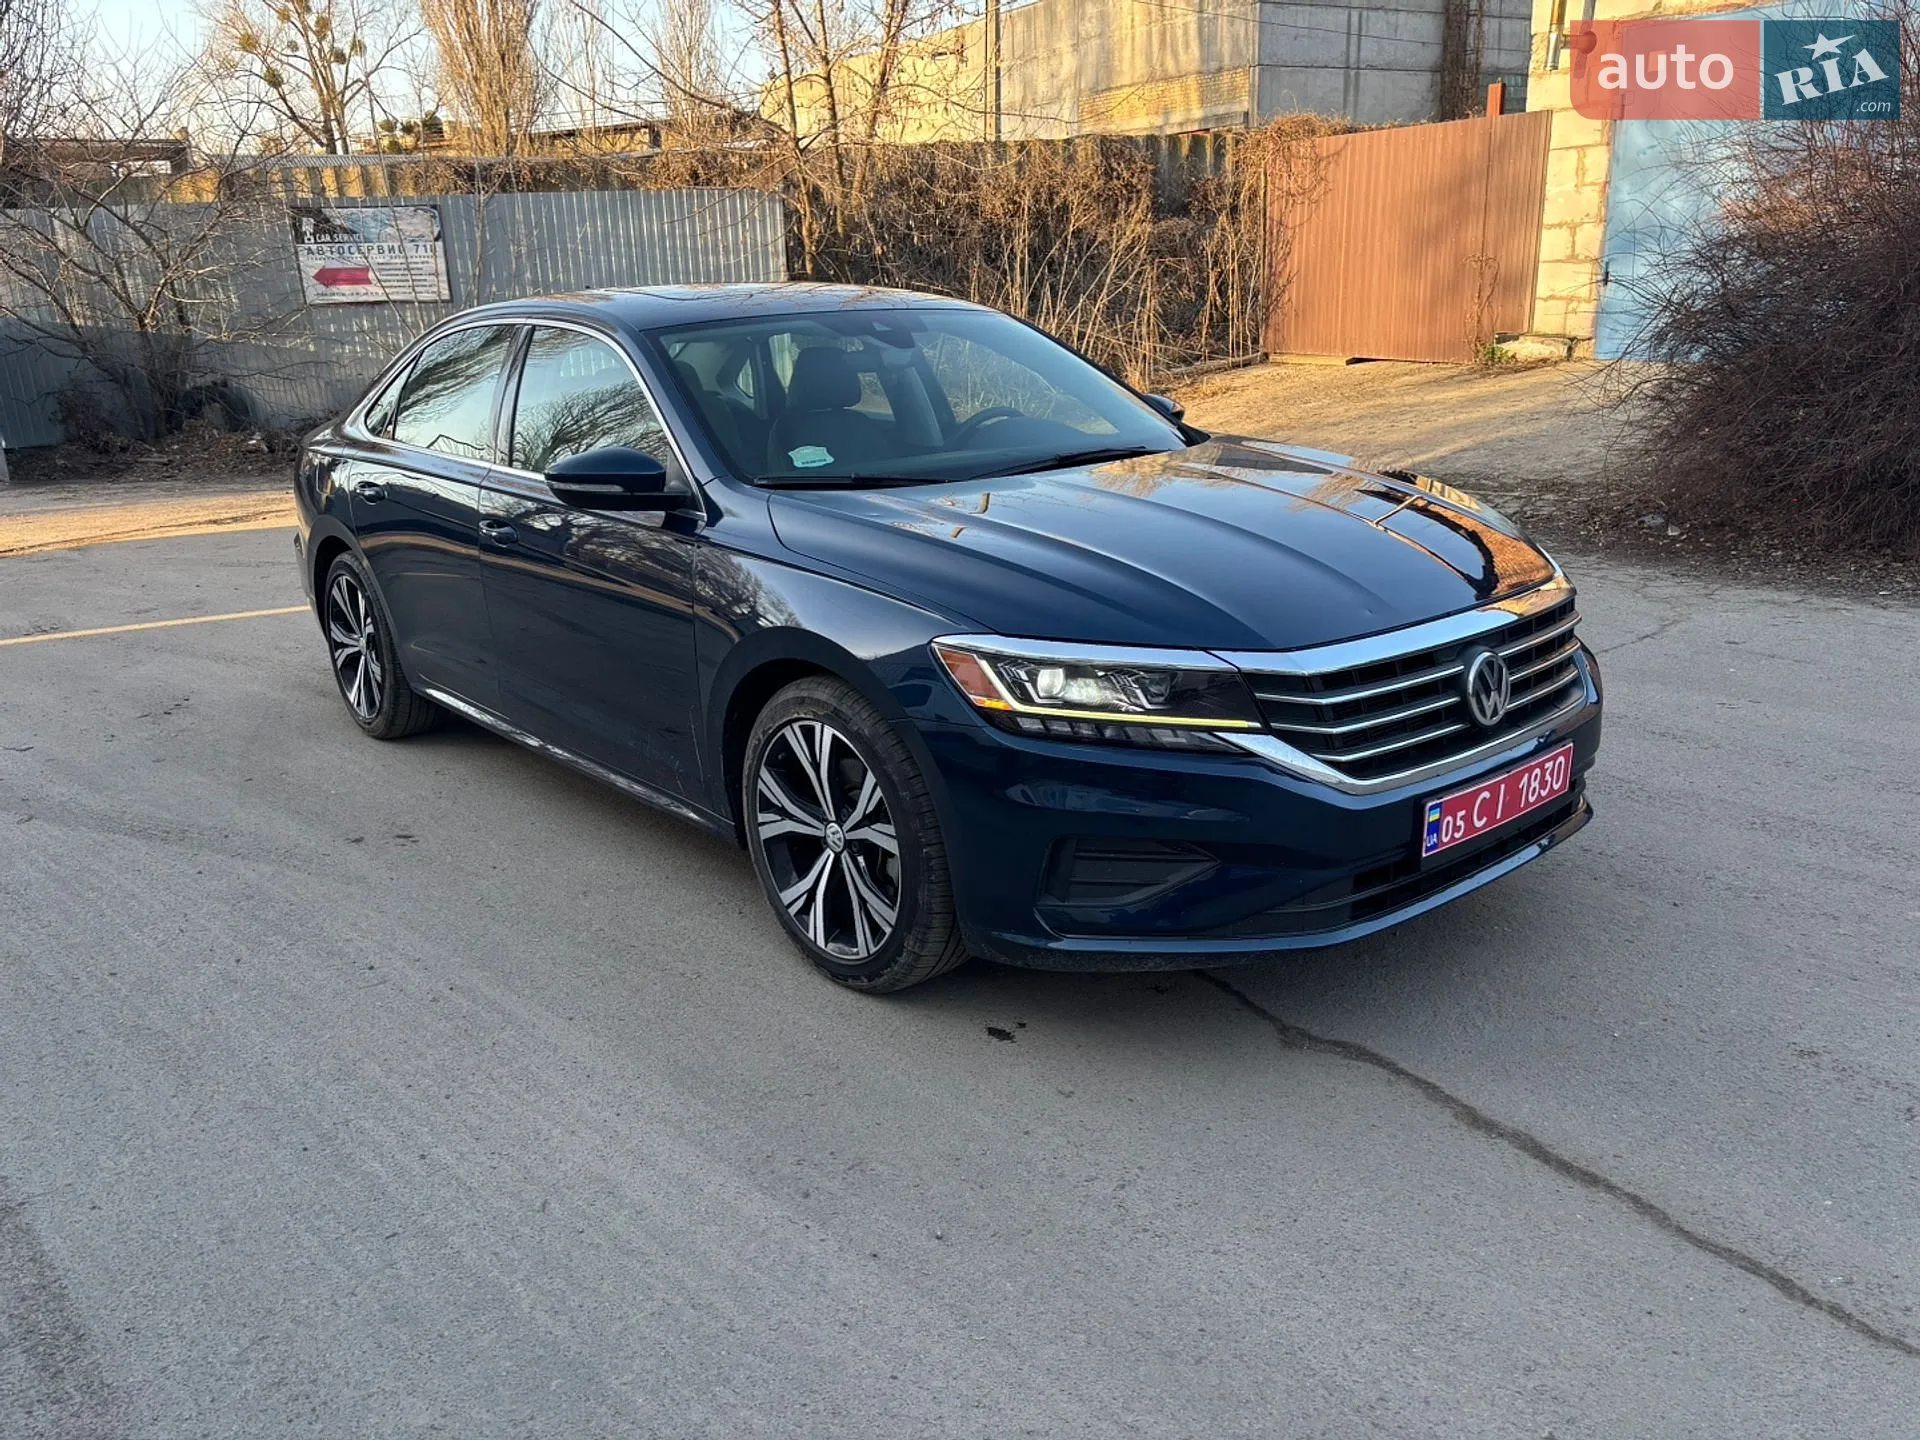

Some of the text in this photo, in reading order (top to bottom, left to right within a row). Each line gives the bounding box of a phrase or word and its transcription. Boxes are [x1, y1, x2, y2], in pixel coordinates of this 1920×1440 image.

[316, 233, 331, 243] CAR
[1442, 810, 1466, 843] 05
[1519, 755, 1565, 808] 1830
[1426, 832, 1438, 847] UA
